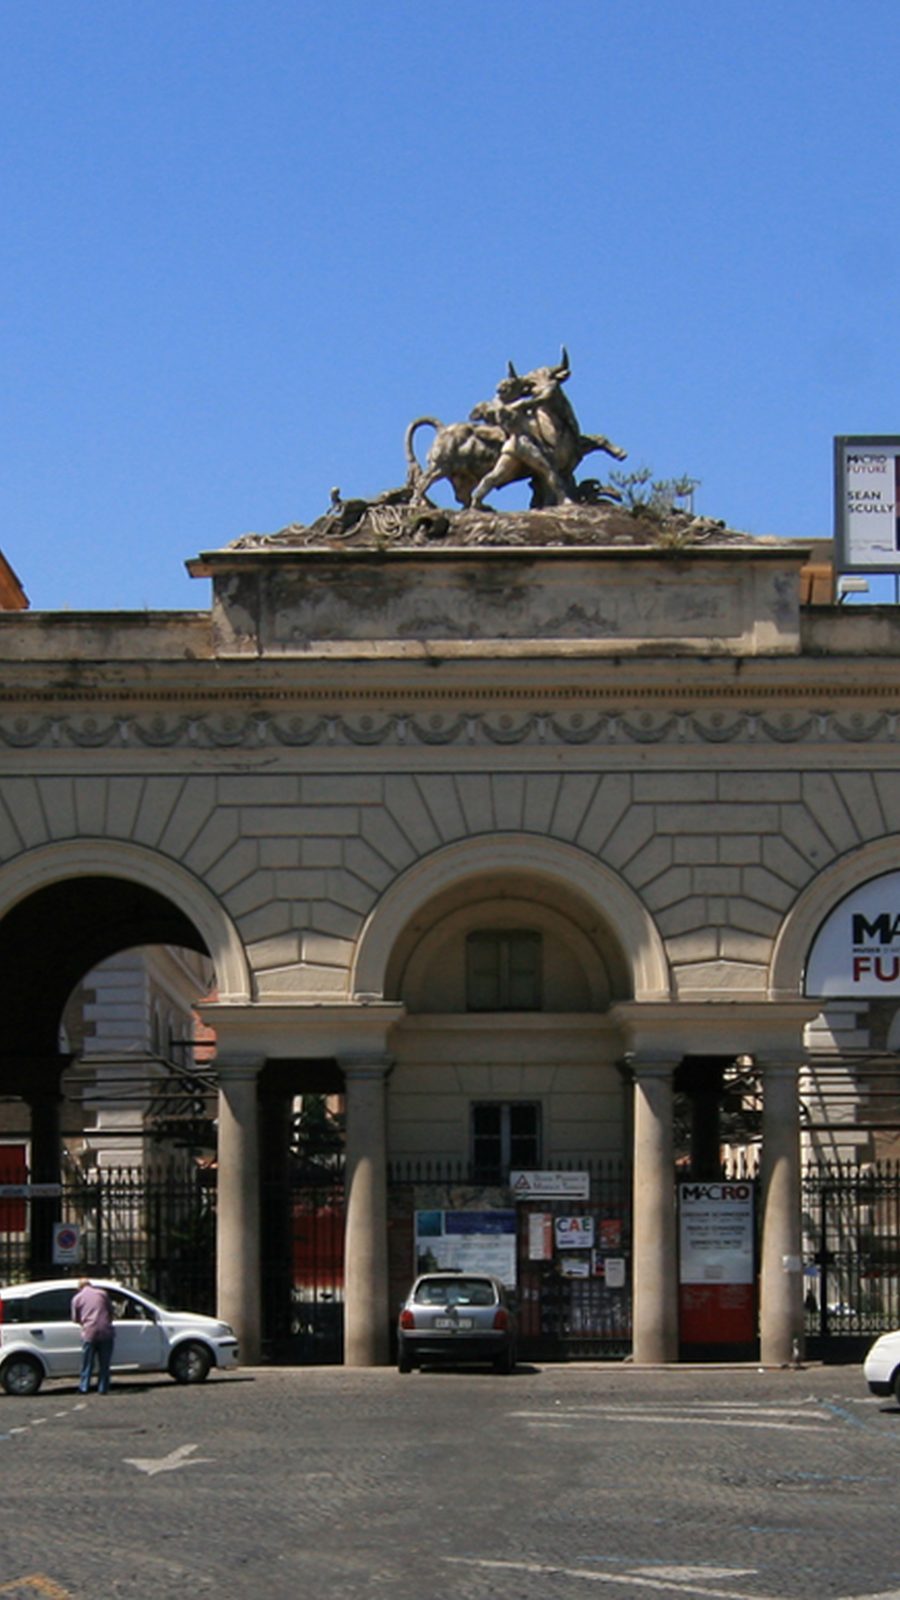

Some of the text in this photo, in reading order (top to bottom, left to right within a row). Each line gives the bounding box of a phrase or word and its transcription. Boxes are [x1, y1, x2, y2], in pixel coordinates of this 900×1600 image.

[847, 491, 881, 500] SEAN
[847, 504, 894, 513] SCULLY
[852, 957, 900, 981] FU
[682, 1185, 750, 1200] MACRO
[556, 1217, 592, 1232] CAE
